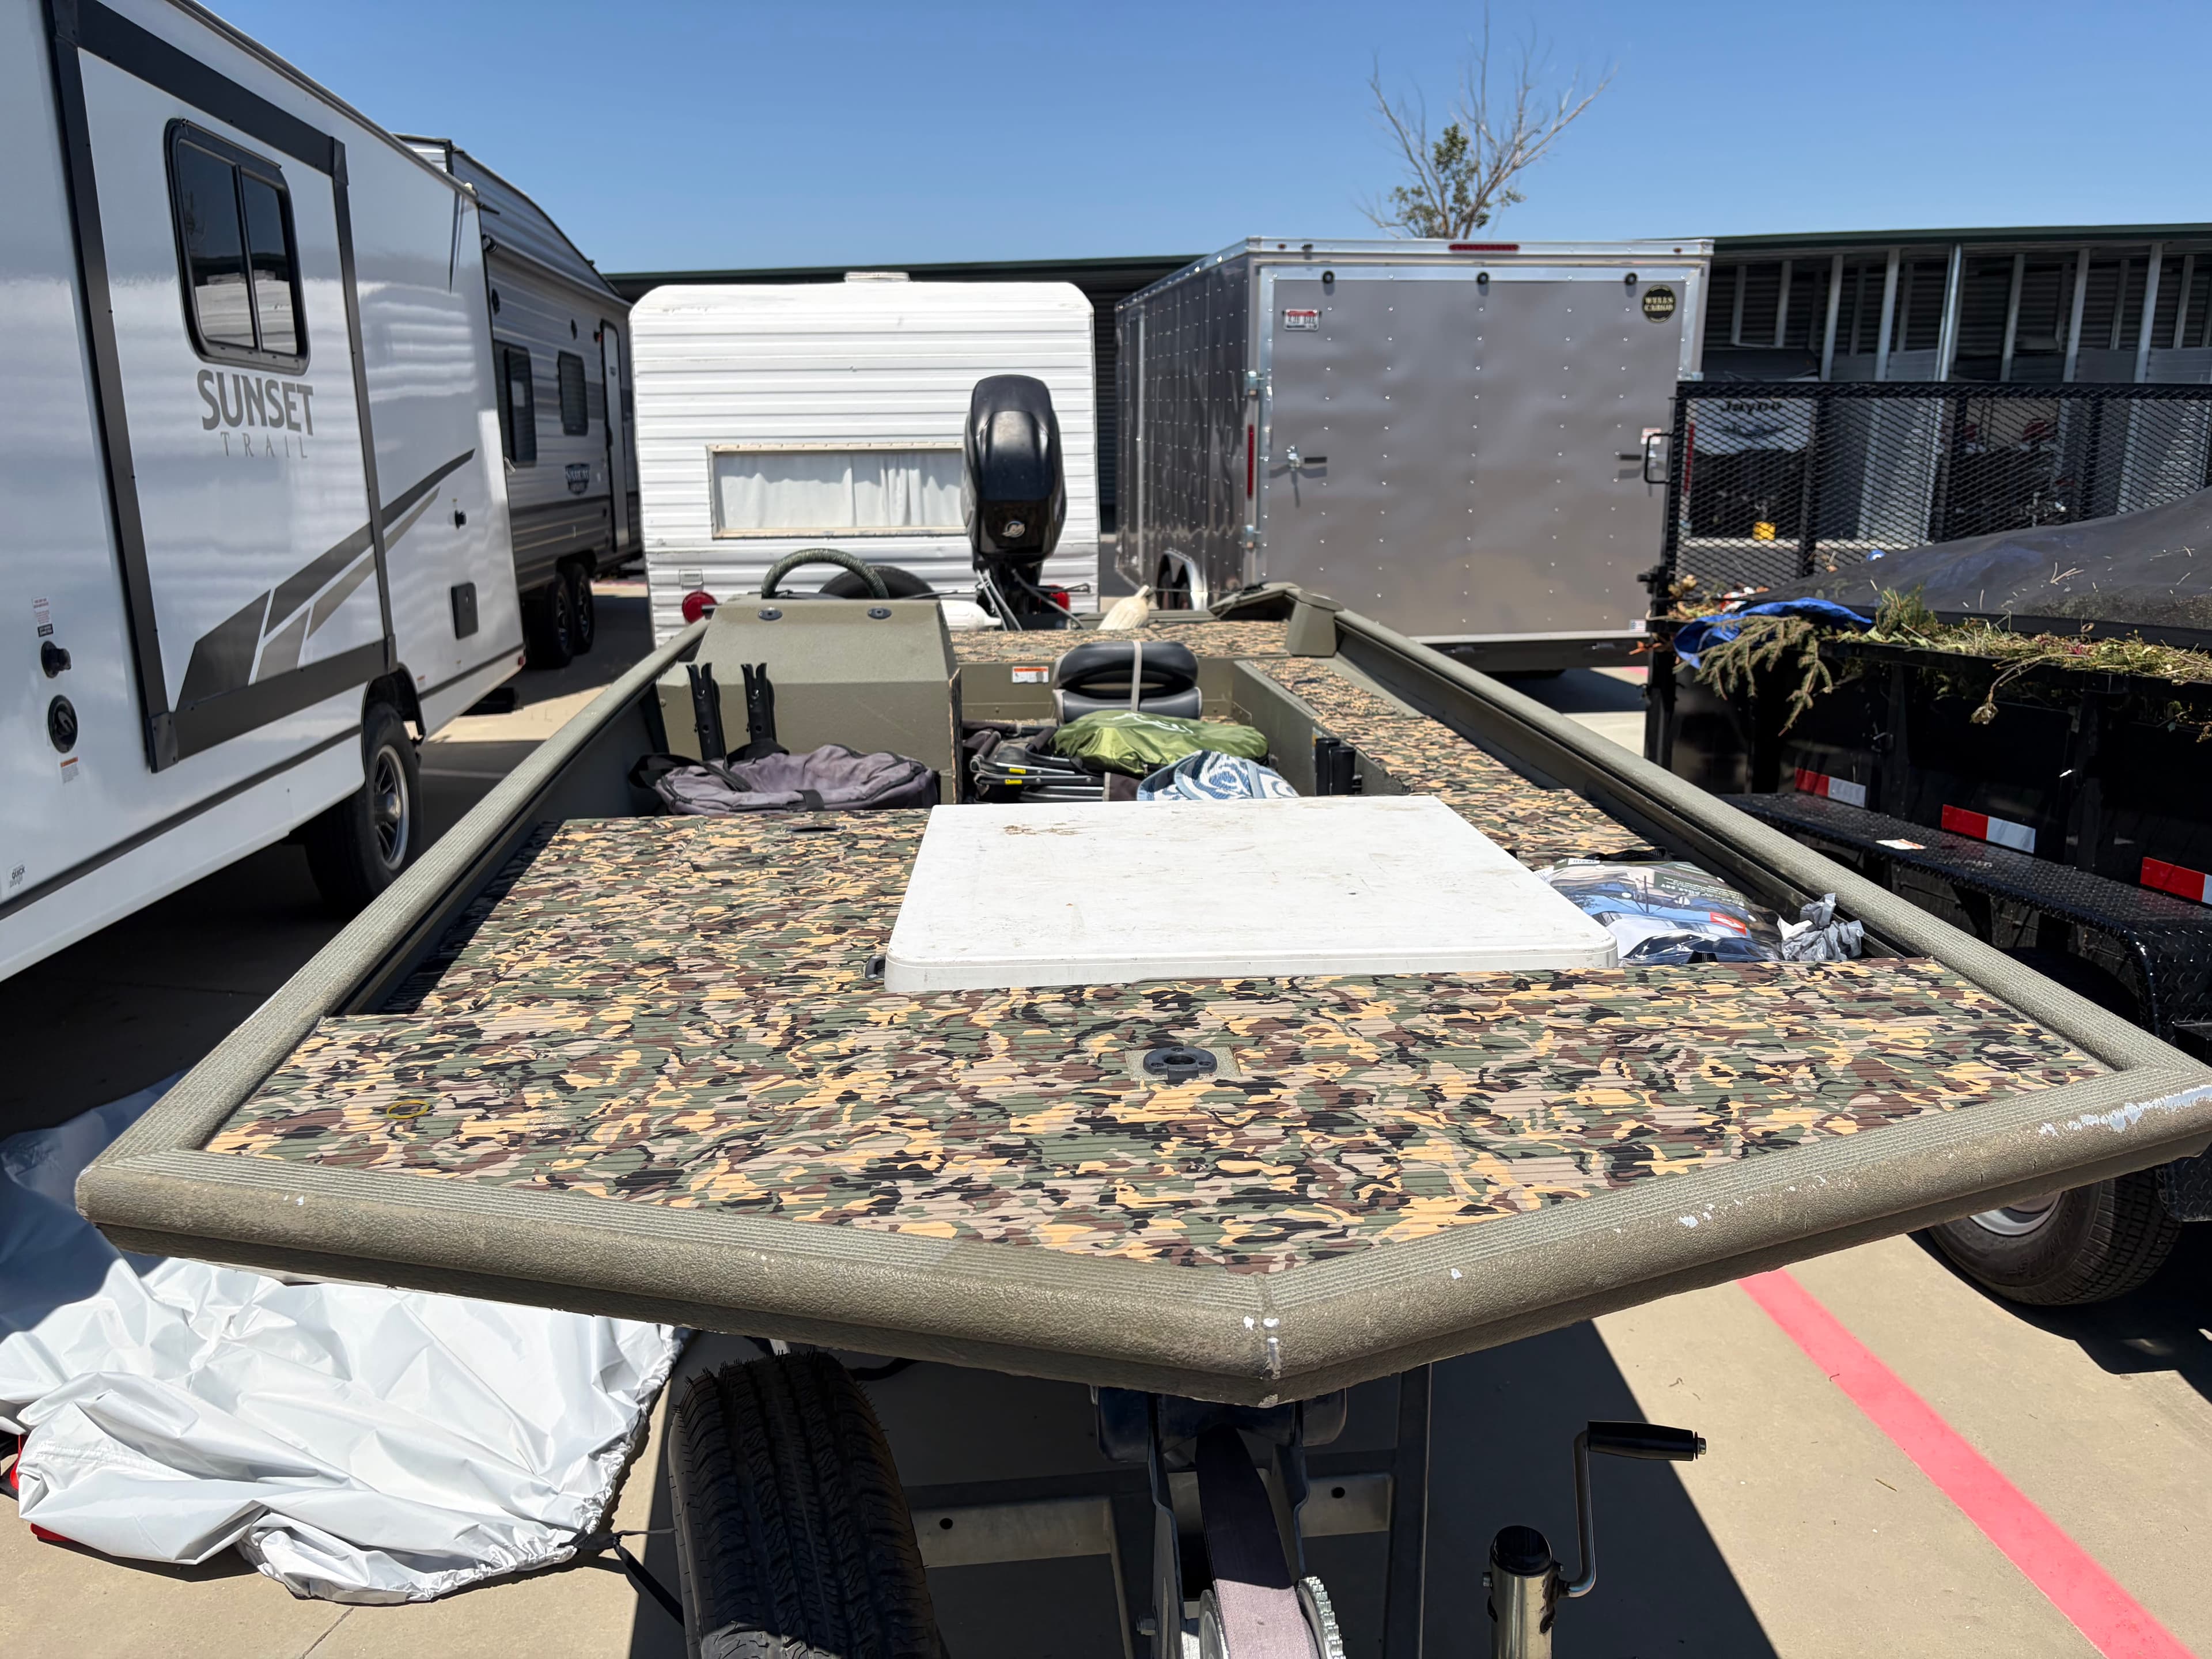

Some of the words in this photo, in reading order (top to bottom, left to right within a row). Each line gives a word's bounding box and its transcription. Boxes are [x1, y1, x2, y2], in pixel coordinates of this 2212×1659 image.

[1645, 296, 1673, 304] WELLS
[197, 369, 314, 436] SUNSET
[220, 431, 308, 458] TRAIL
